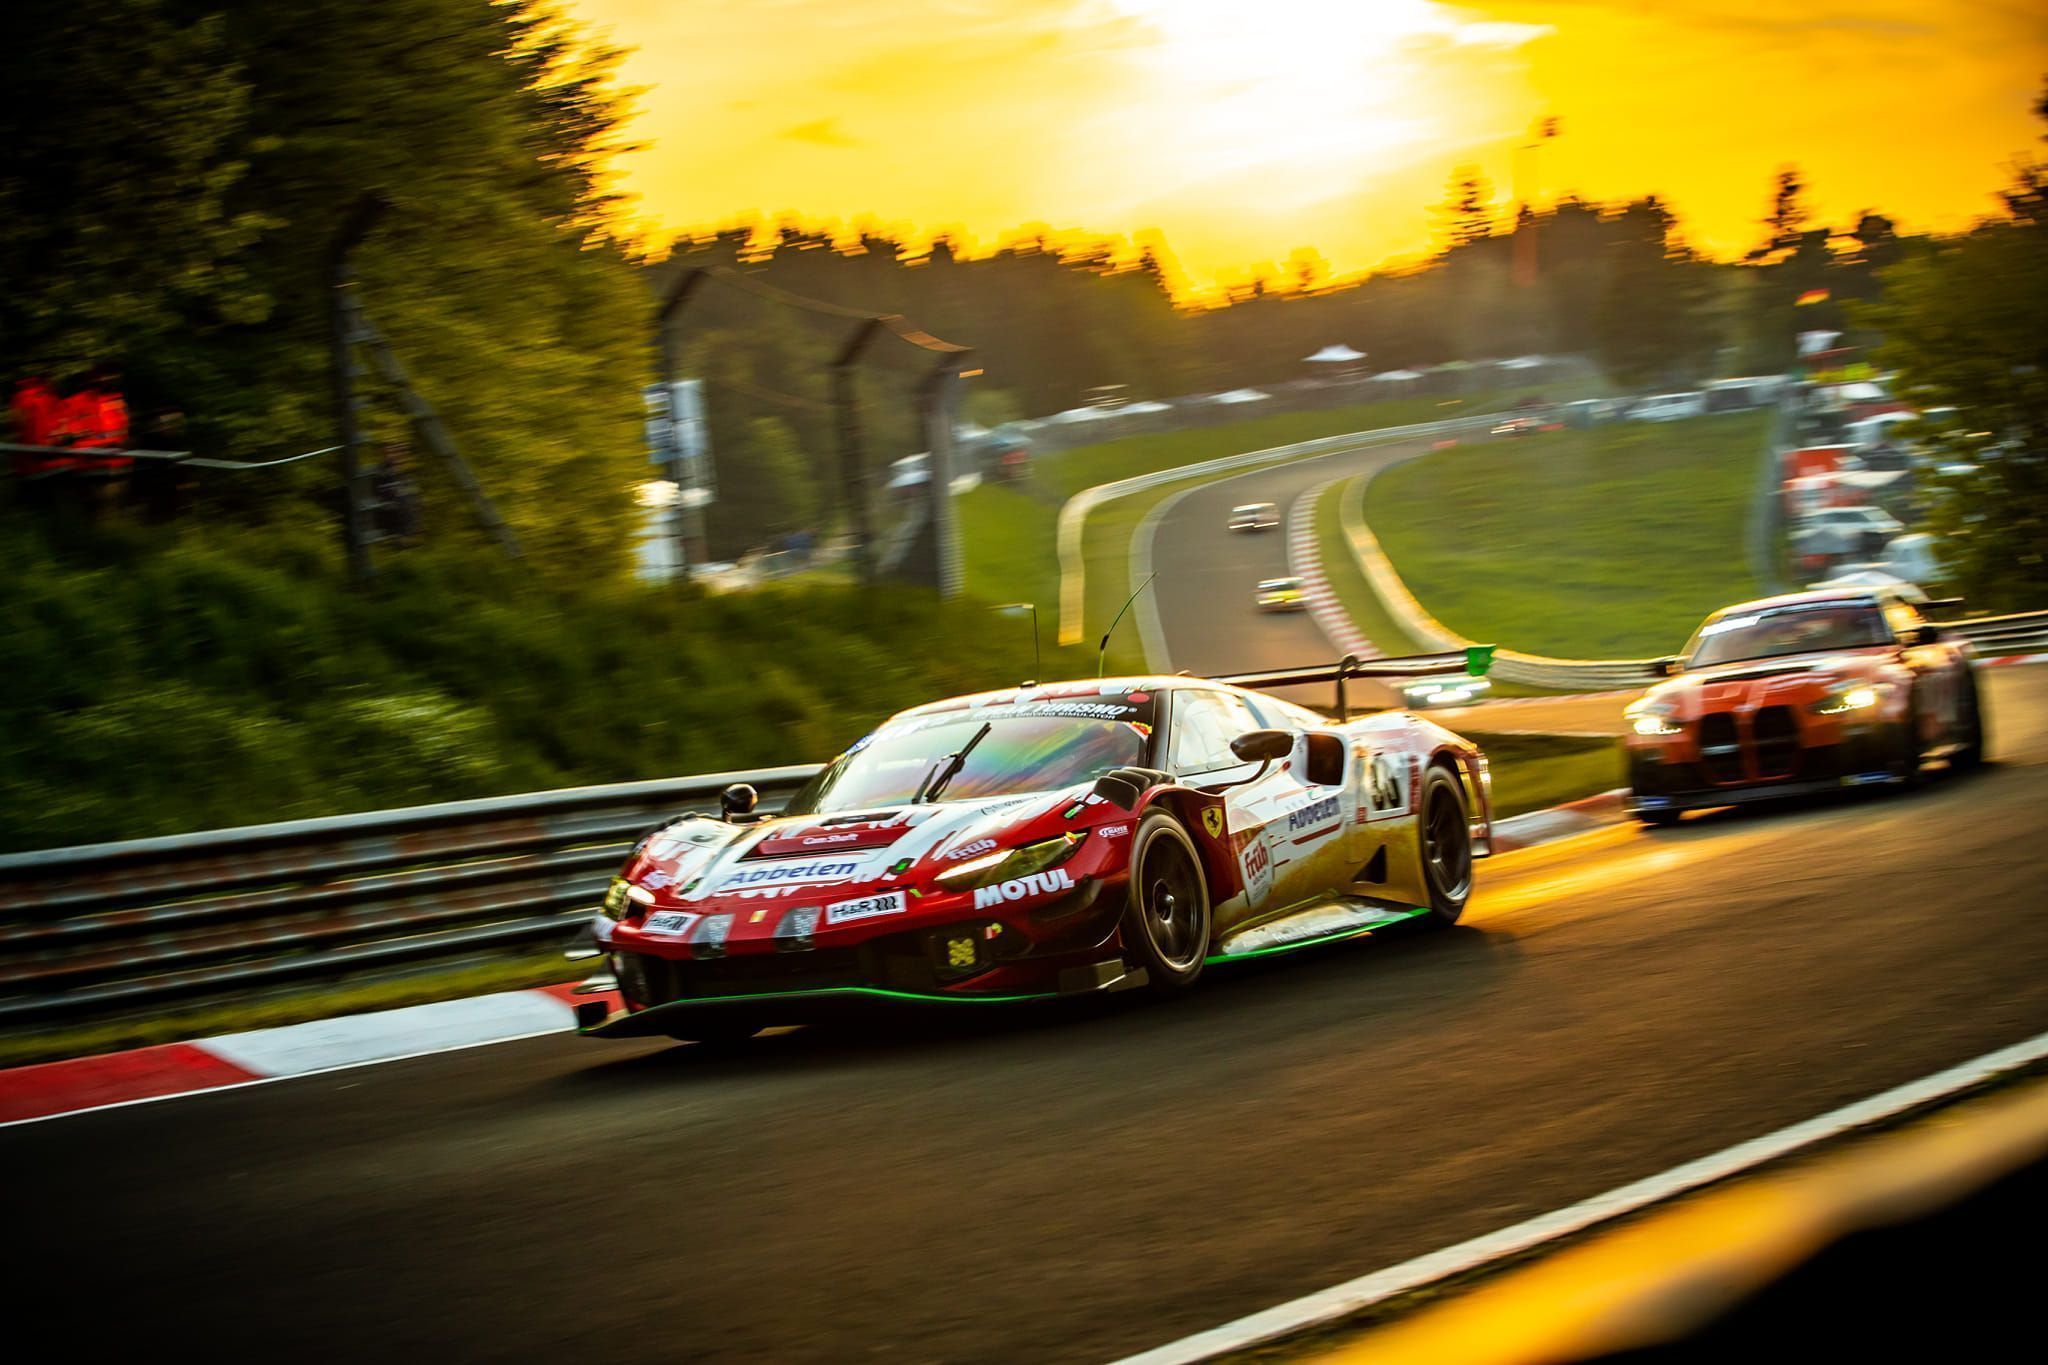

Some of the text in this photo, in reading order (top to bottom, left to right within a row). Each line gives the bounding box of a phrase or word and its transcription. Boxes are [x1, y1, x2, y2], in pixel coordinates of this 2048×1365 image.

[1034, 703, 1128, 716] TURISMO
[1057, 711, 1116, 720] SIMULATOR
[1244, 840, 1268, 880] früh
[721, 861, 857, 887] Abbeten
[974, 868, 1075, 910] MOTUL
